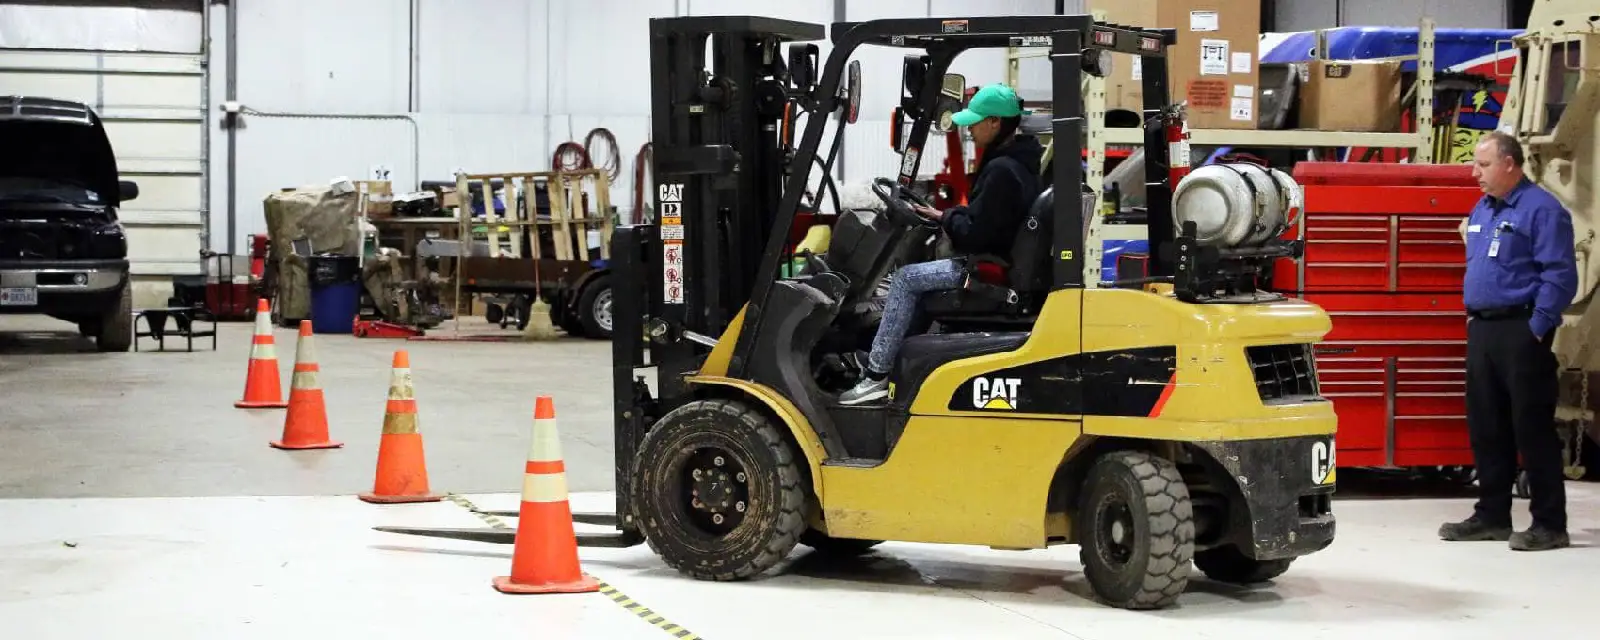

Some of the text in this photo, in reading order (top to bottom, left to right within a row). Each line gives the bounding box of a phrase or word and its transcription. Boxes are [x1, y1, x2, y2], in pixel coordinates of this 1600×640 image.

[659, 184, 684, 202] CAT
[973, 377, 1022, 409] CAT
[1311, 441, 1336, 484] CA
